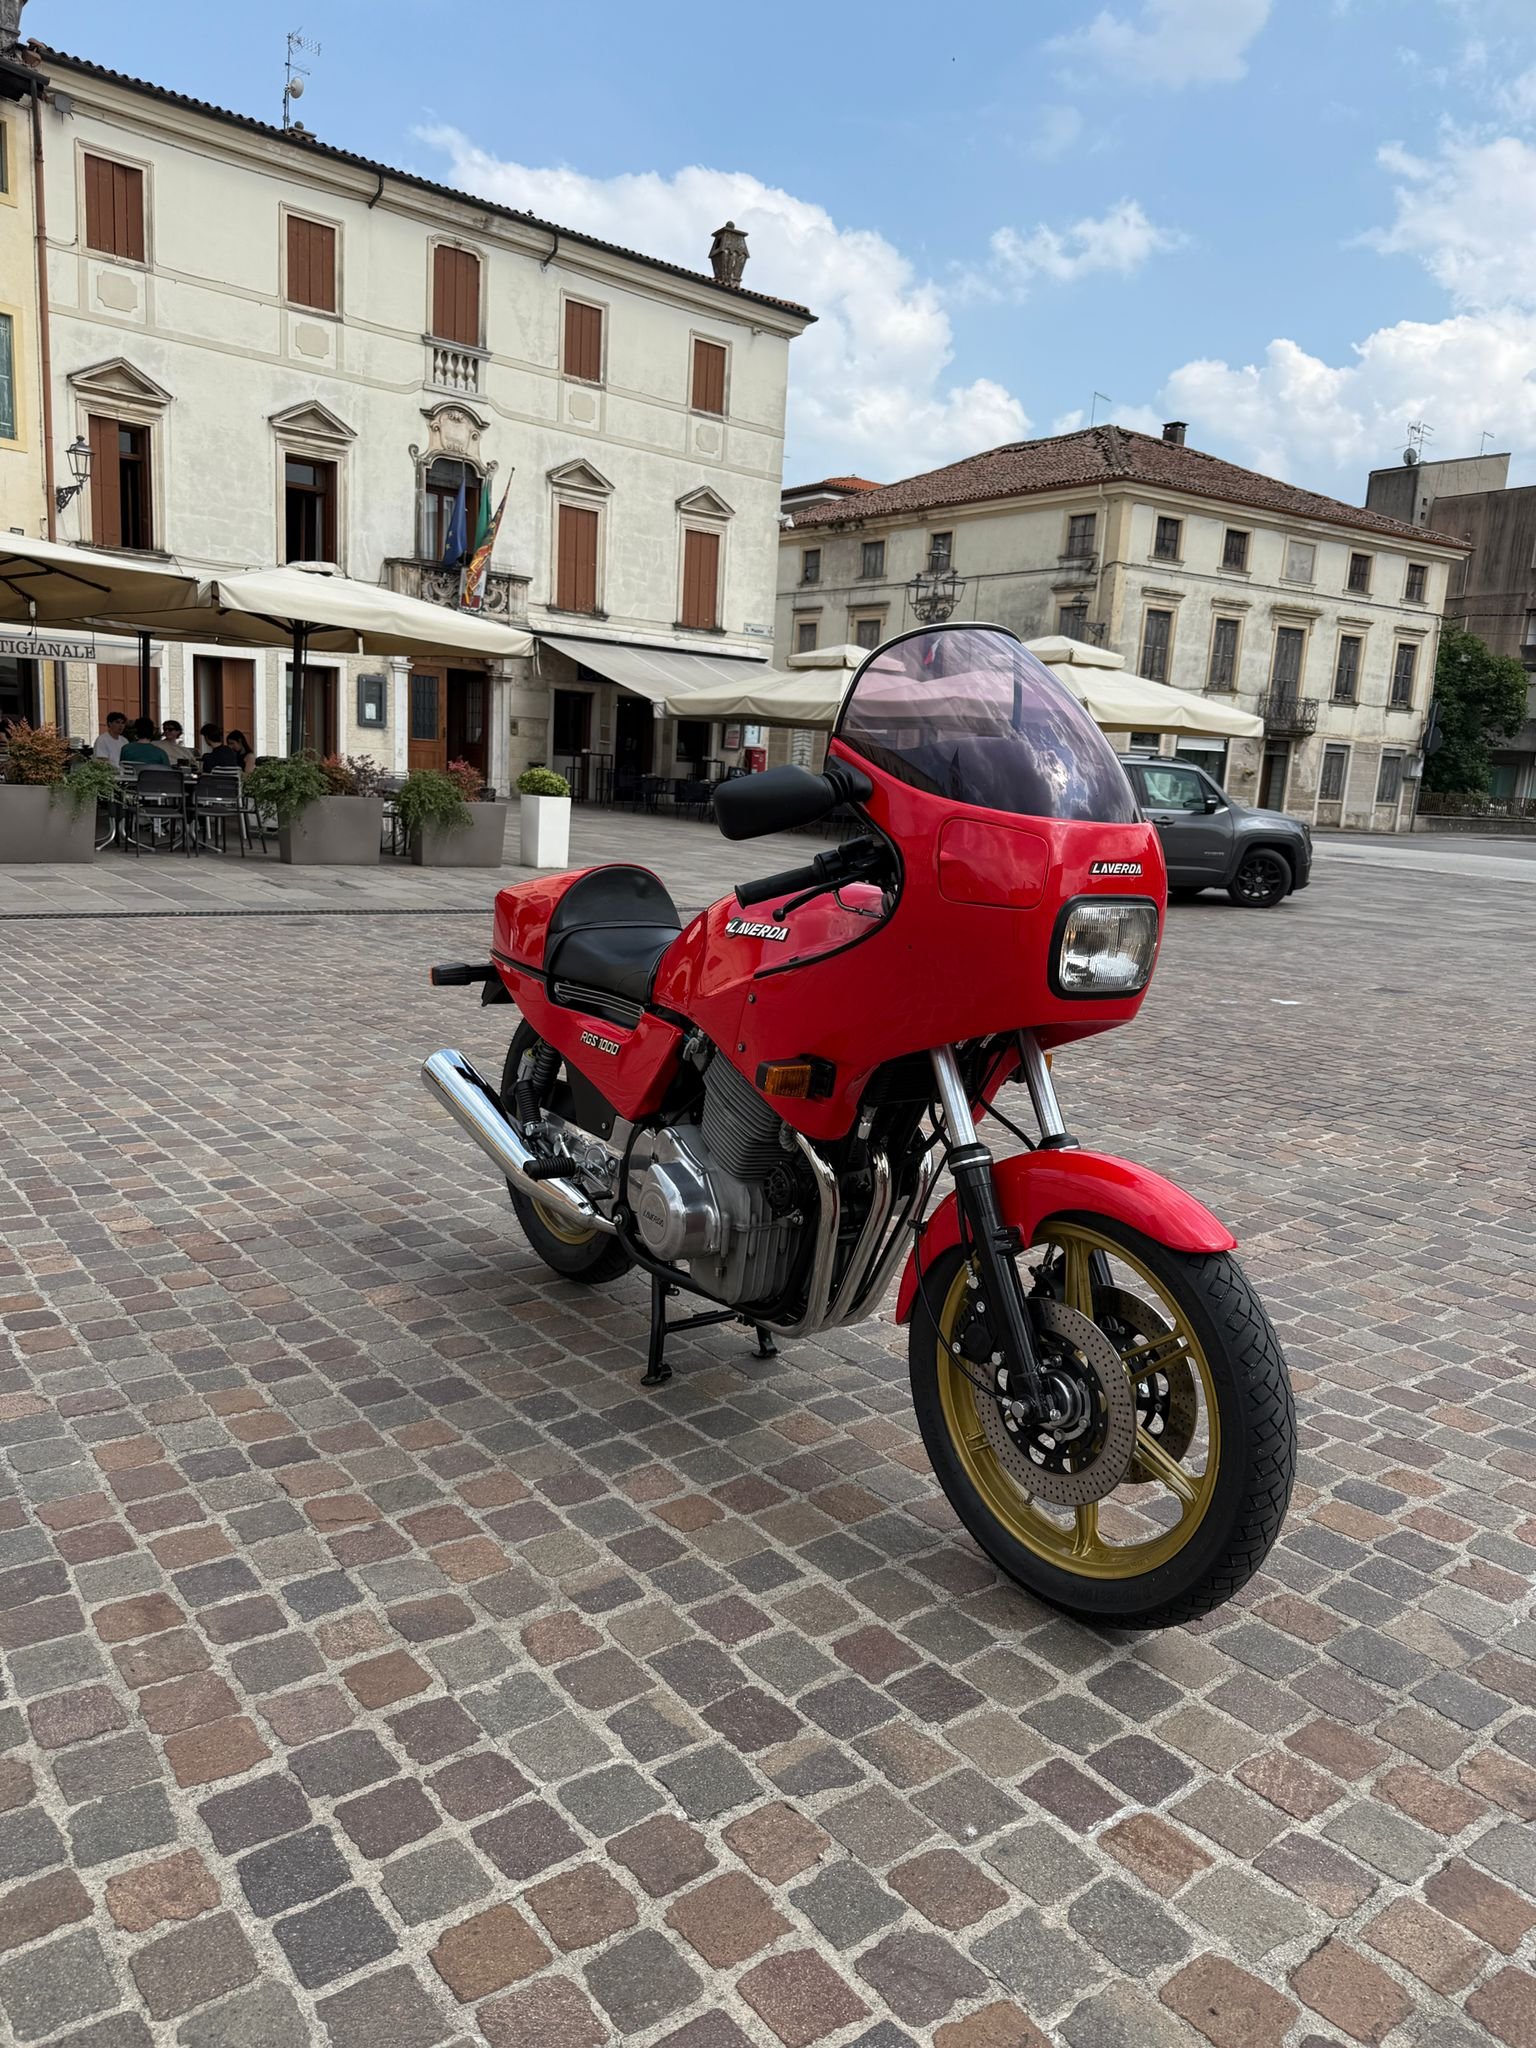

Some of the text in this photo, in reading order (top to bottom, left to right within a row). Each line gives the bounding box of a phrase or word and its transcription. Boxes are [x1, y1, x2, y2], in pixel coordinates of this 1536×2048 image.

[1091, 863, 1142, 874] LAVERDA
[727, 921, 788, 941] LAVERDA
[581, 1031, 619, 1055] RGS 1000
